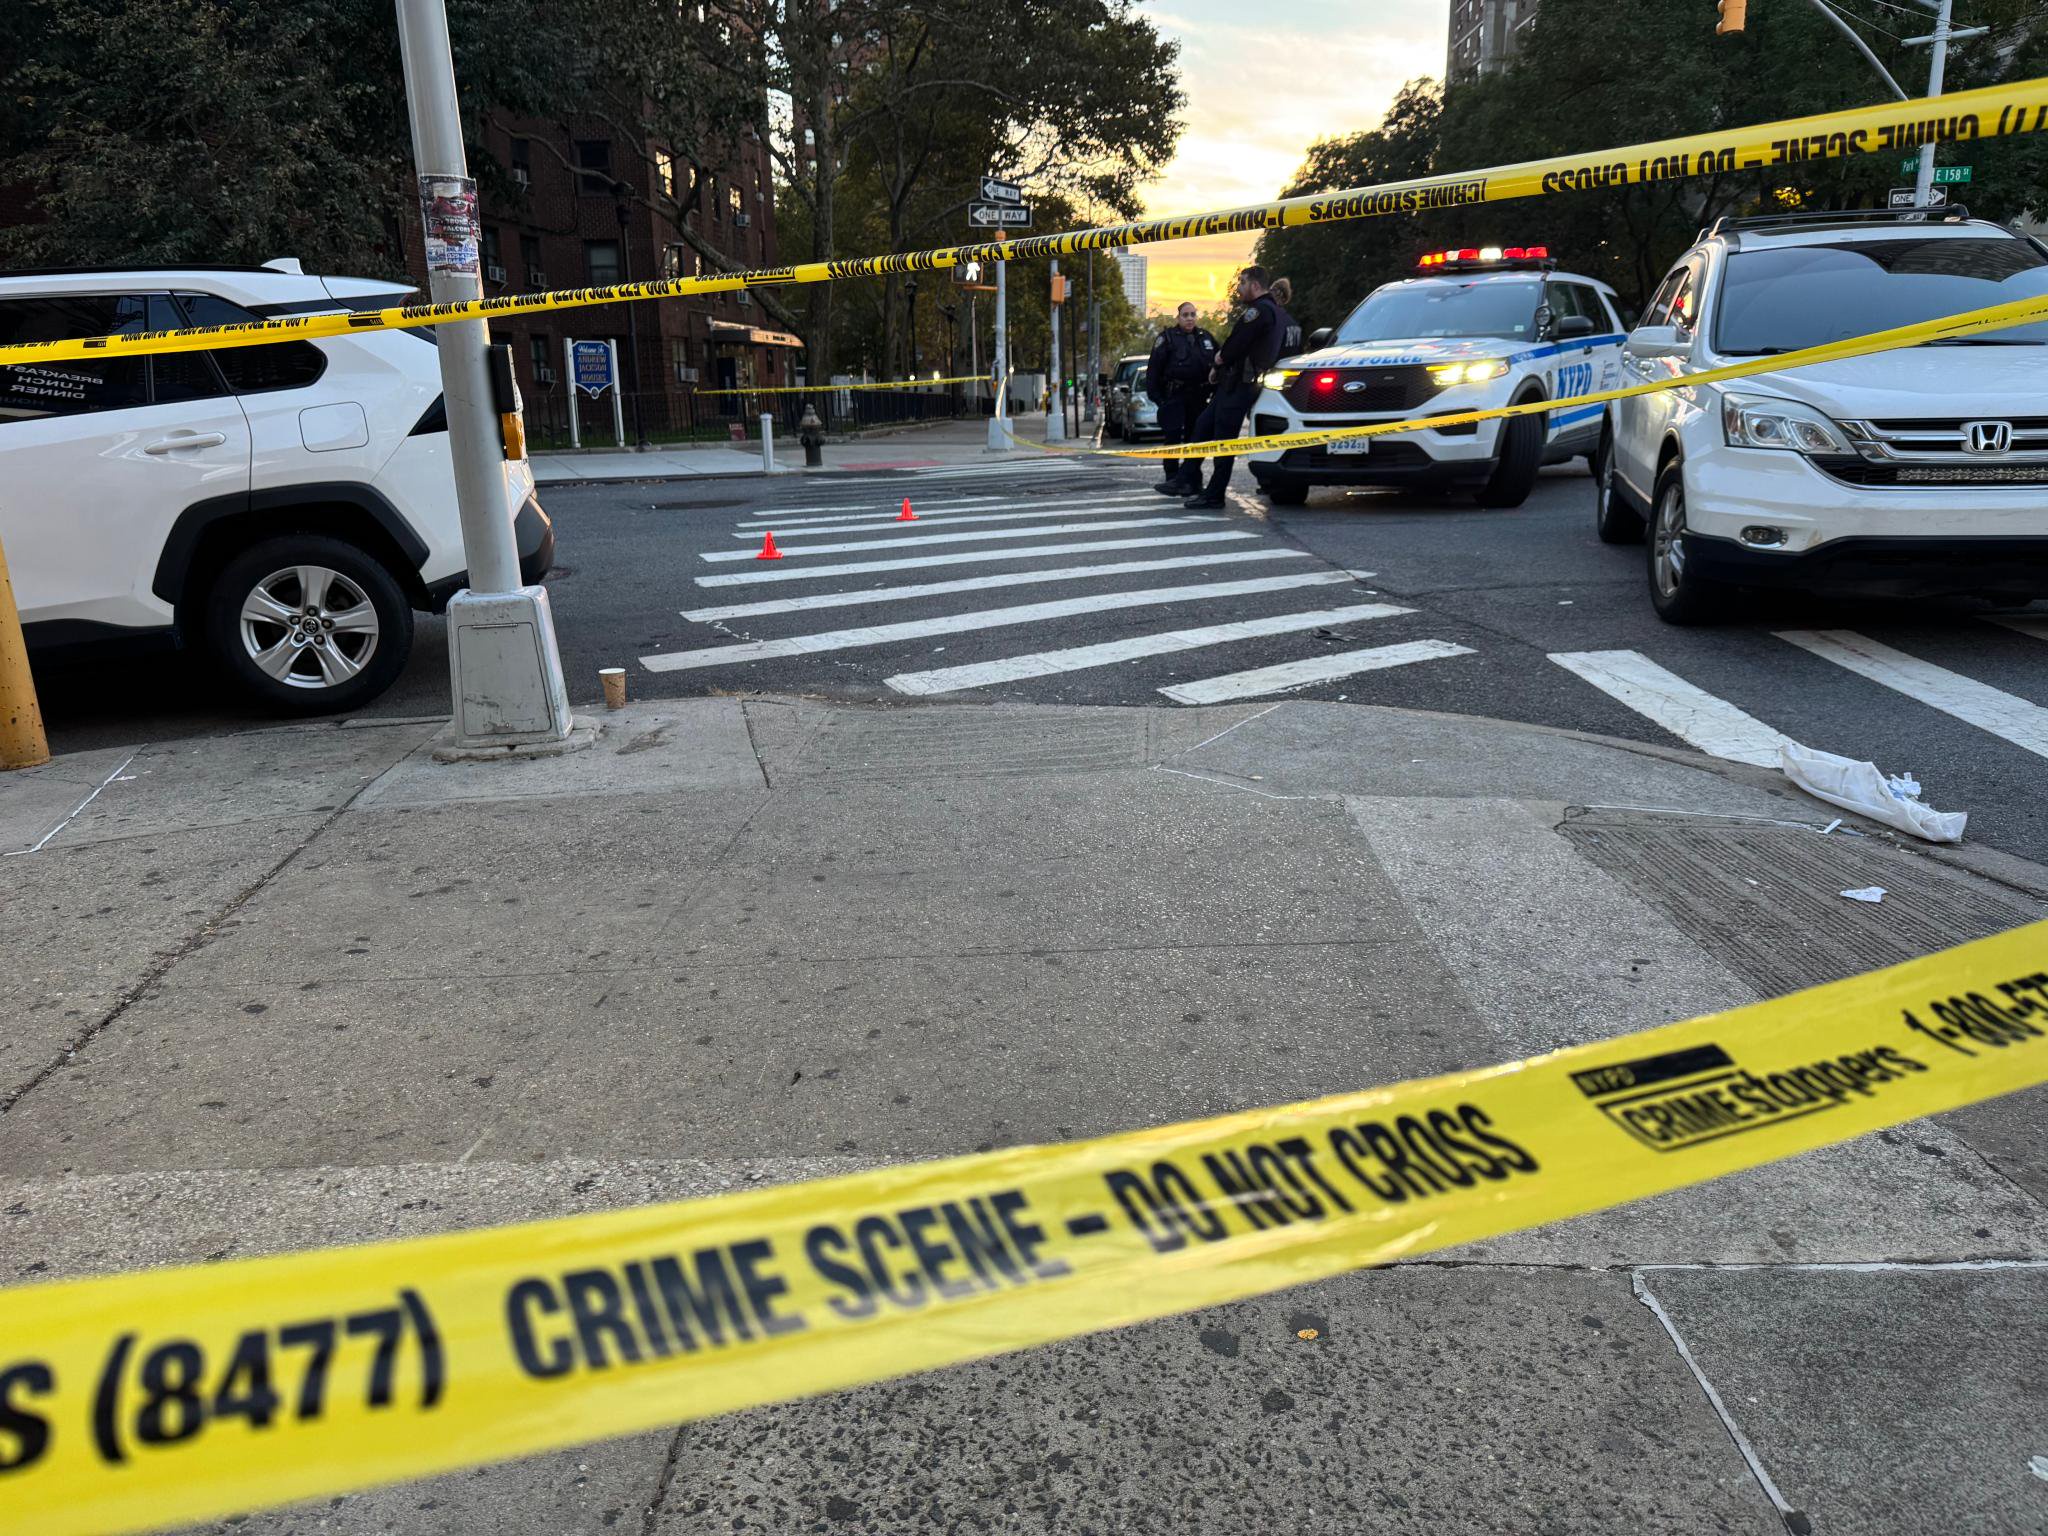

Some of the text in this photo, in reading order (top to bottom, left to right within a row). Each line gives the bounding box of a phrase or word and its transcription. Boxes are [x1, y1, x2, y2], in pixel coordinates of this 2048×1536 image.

[1936, 169, 1942, 182] E
[1945, 168, 1961, 181] 158
[1895, 195, 1912, 203] ONE
[979, 211, 1022, 220] ONE WAY
[1357, 356, 1422, 366] POLICE
[1556, 362, 1592, 400] NYPD
[92, 1287, 446, 1465] (8477)
[505, 1237, 808, 1381] CRIME
[805, 1189, 1073, 1318] SCENE
[1104, 1159, 1229, 1254] DO
[1200, 1138, 1355, 1232] NOT
[1331, 1103, 1540, 1215] CROSS
